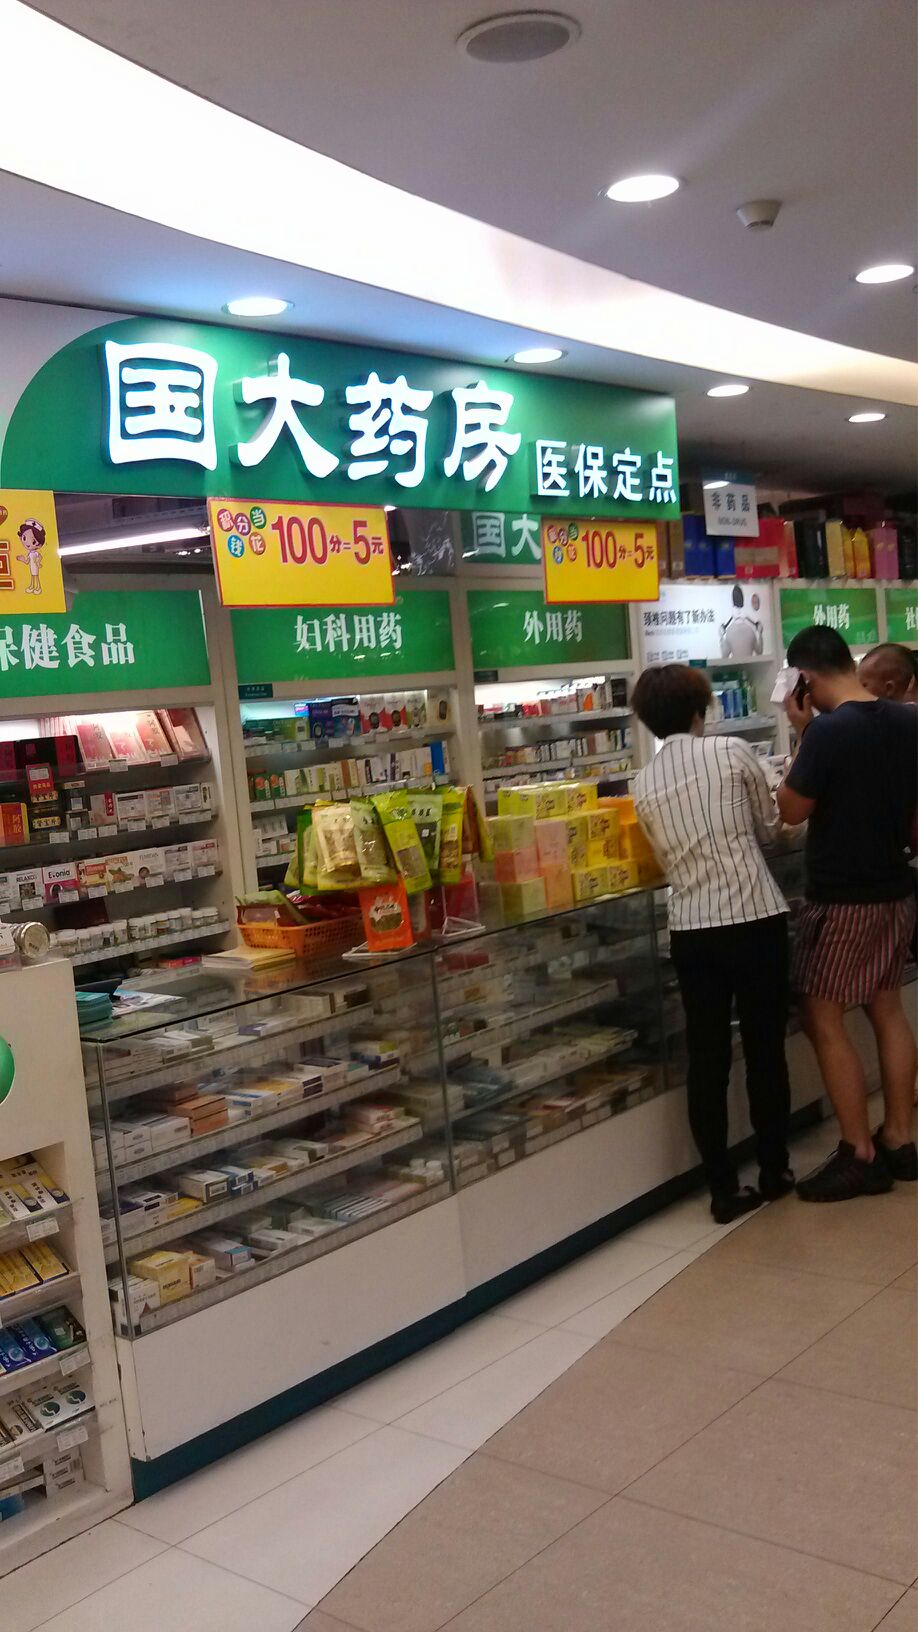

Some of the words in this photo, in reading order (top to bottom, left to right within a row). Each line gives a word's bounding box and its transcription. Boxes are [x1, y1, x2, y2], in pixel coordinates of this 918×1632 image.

[104, 340, 522, 492] 国大药房
[535, 439, 677, 503] 医保定点
[271, 515, 384, 565] 100分=5元
[471, 512, 543, 560] 国大
[581, 530, 655, 569] 100分=5元
[294, 611, 403, 653] 妇科用药
[522, 609, 583, 644] 外用药
[813, 603, 850, 630] 外用药
